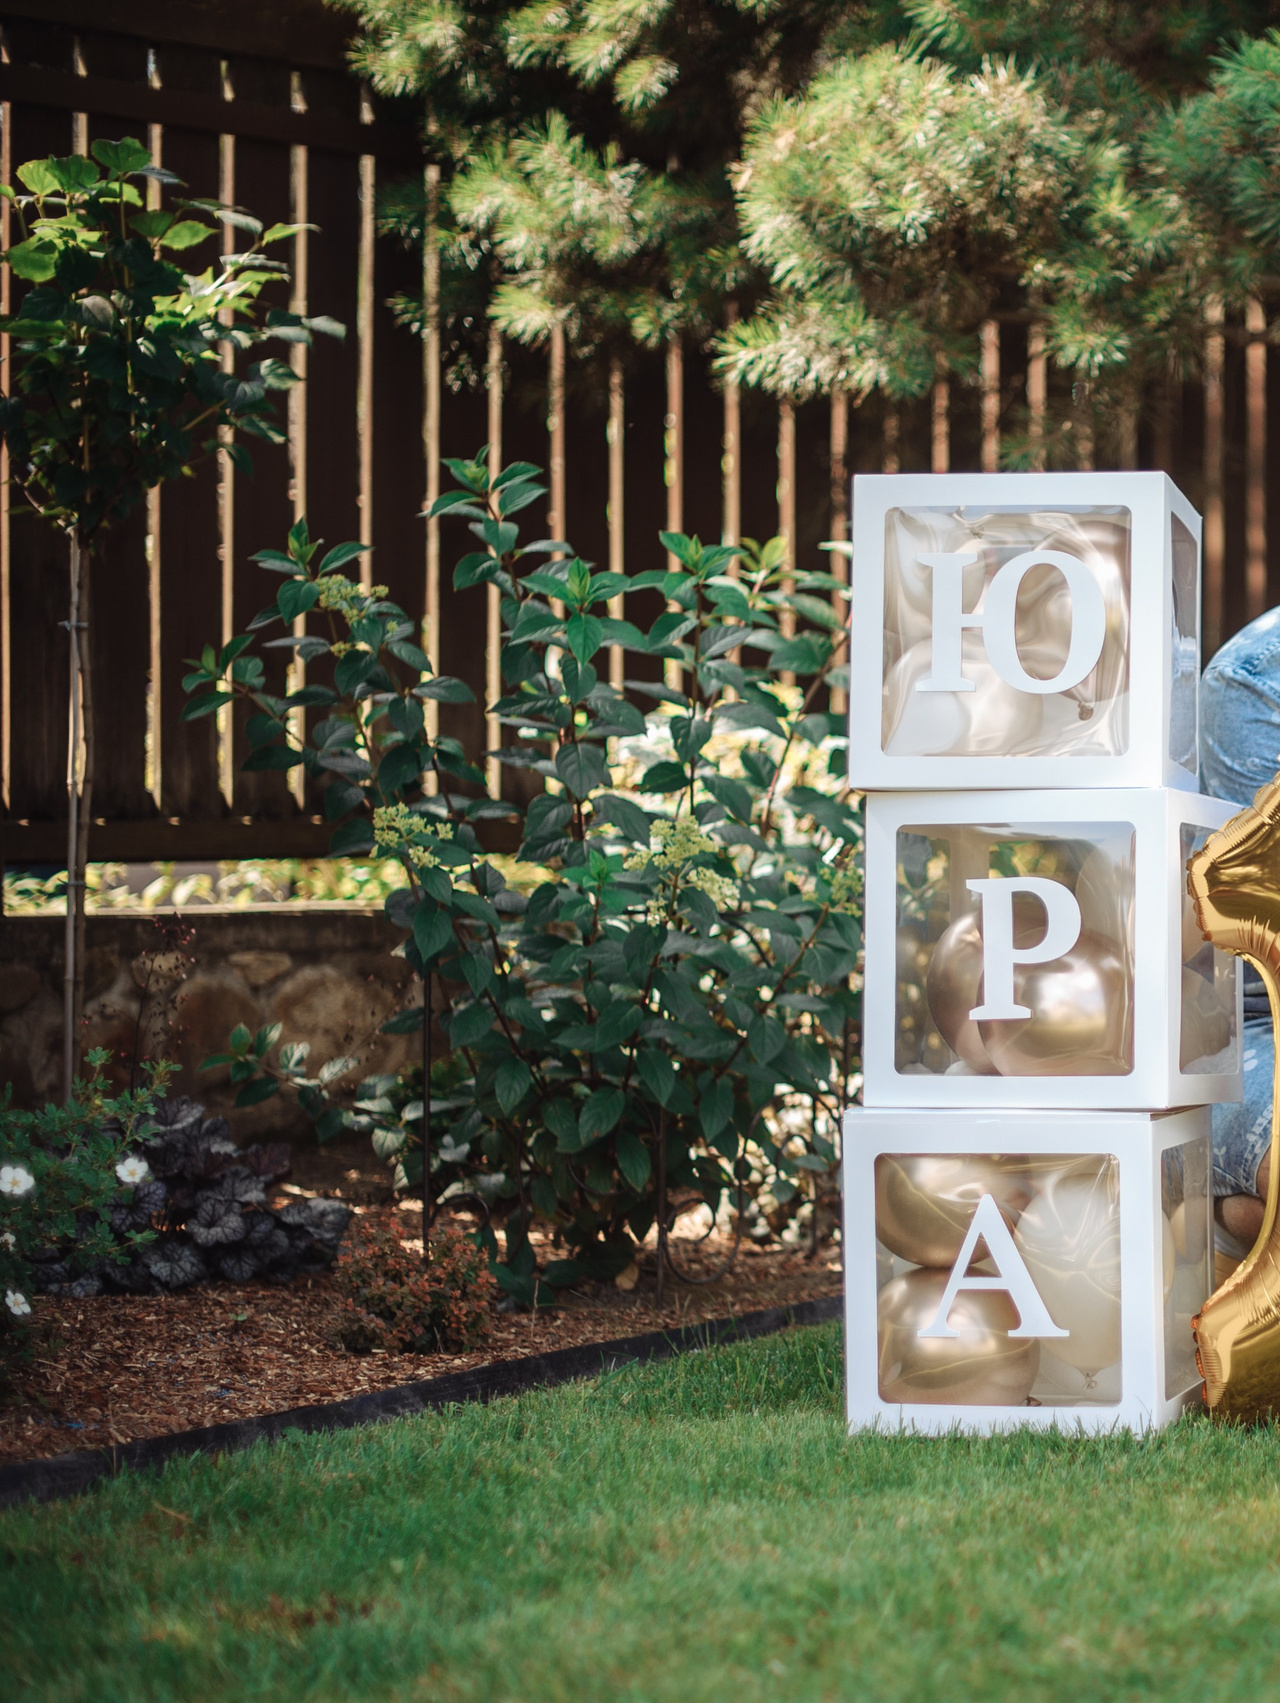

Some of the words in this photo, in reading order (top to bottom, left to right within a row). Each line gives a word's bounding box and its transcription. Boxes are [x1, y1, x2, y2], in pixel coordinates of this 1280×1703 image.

[915, 550, 1106, 694] Ю
[966, 876, 1081, 1020] Р
[917, 1193, 1070, 1337] А
